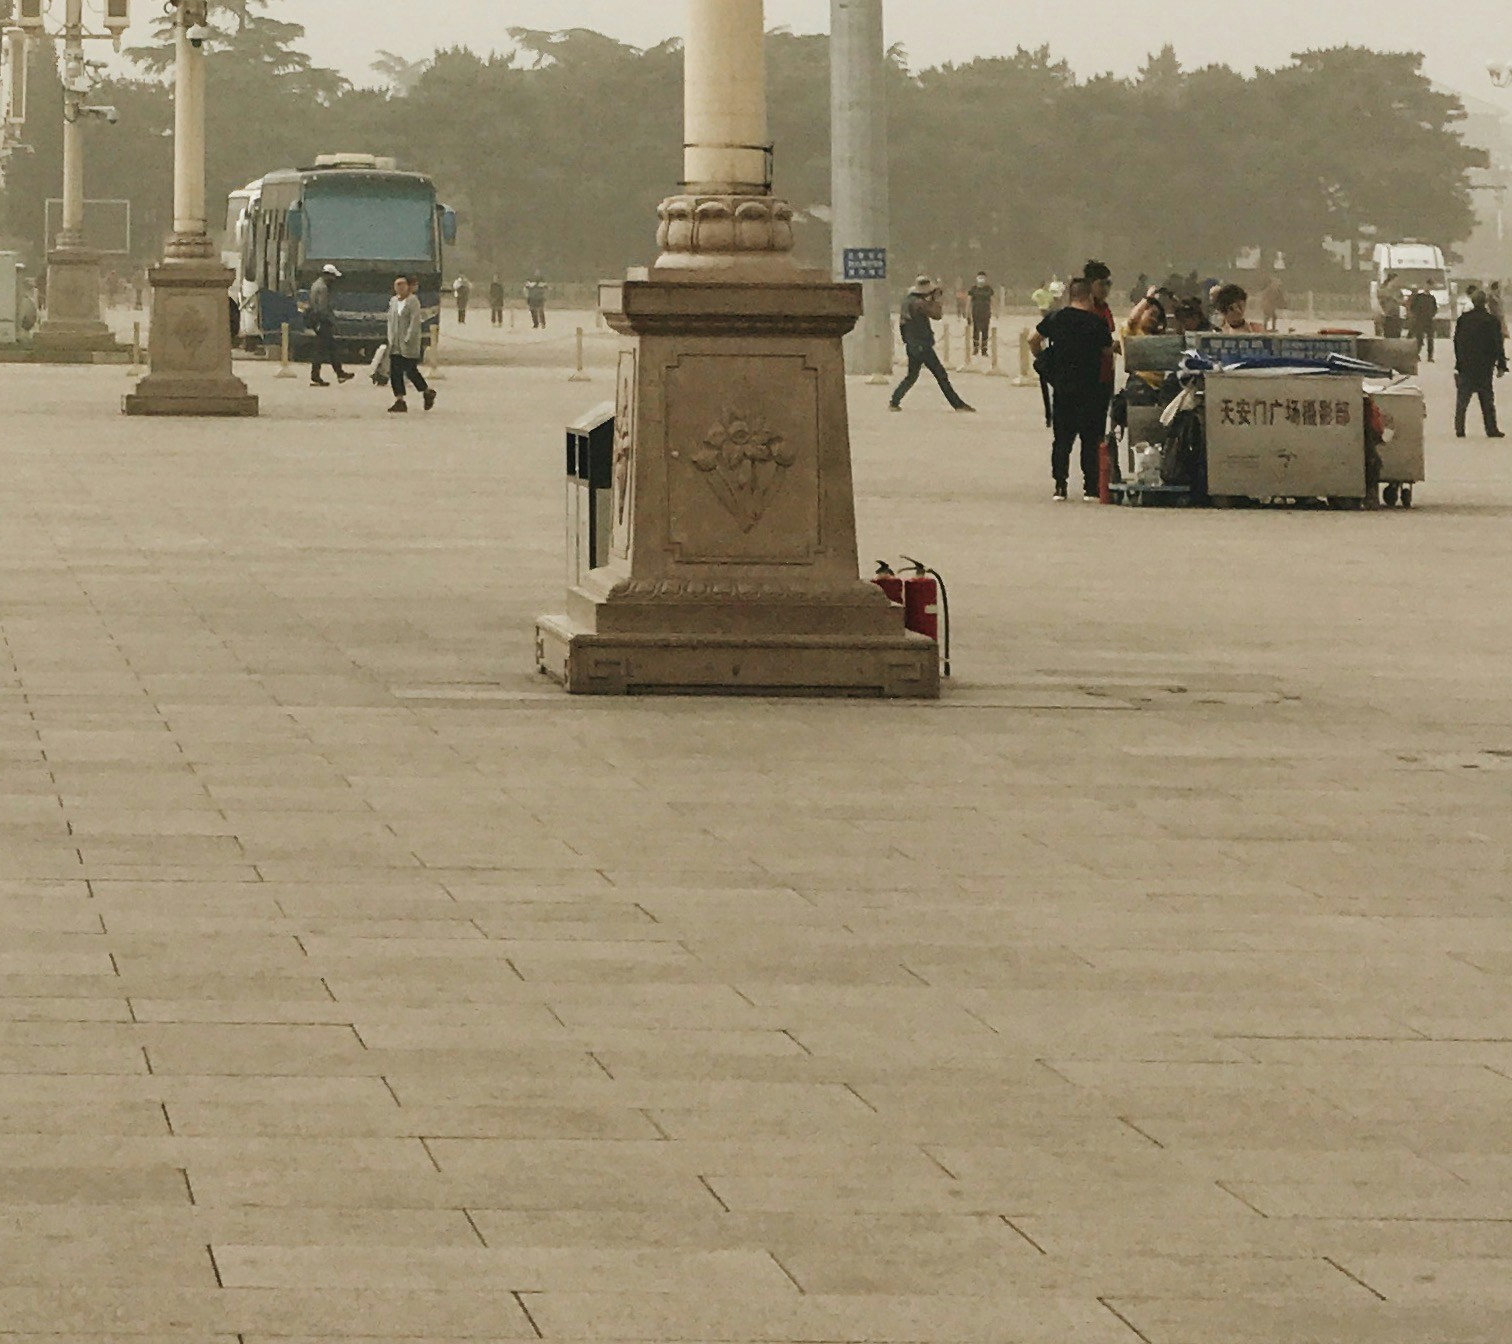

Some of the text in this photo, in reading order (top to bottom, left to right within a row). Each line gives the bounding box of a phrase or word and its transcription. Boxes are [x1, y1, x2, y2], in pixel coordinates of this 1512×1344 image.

[1221, 399, 1351, 426] 天安门广场摄影部
